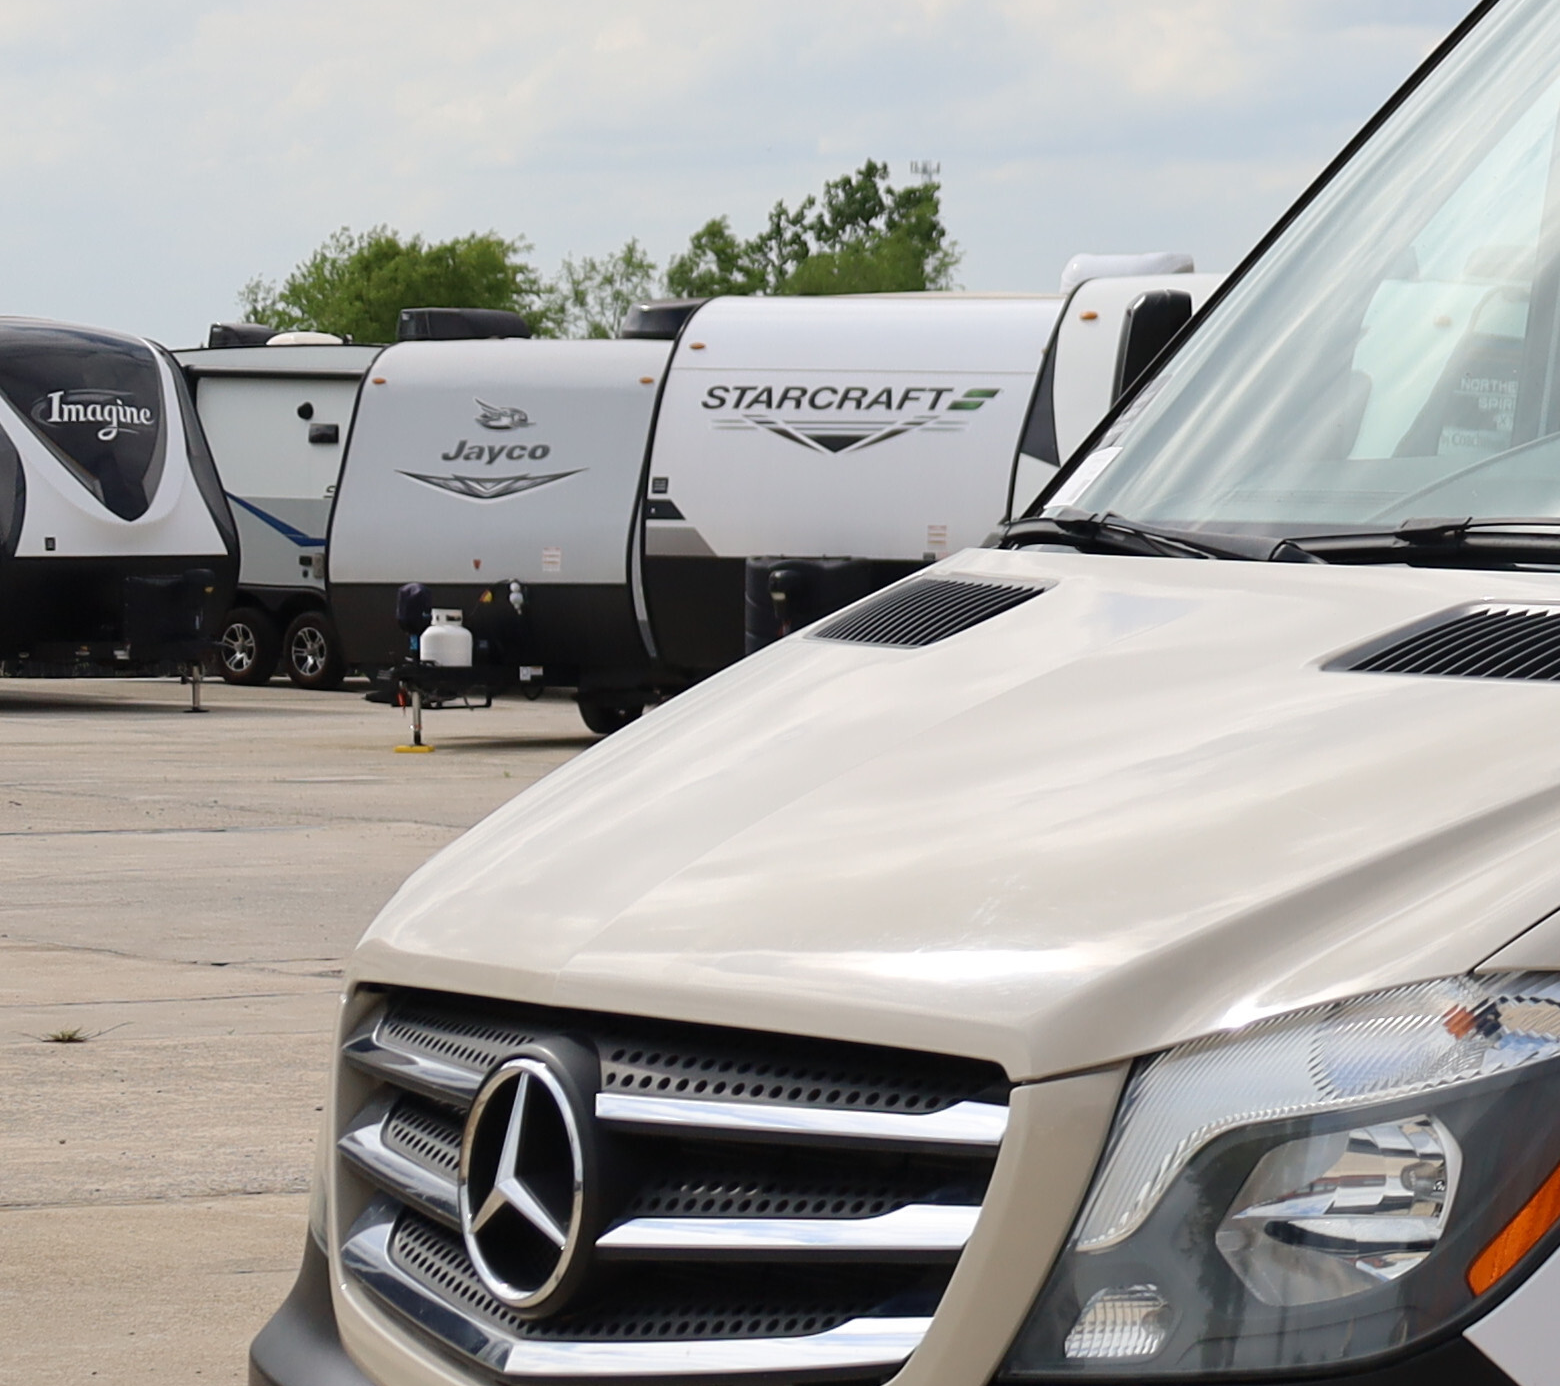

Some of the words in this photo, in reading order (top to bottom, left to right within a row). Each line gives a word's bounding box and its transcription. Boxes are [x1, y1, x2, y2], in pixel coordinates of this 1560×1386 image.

[701, 385, 954, 410] STARCRAFT
[1460, 377, 1519, 394] NORTHE
[46, 390, 155, 441] Imagine
[441, 439, 551, 465] Jayco
